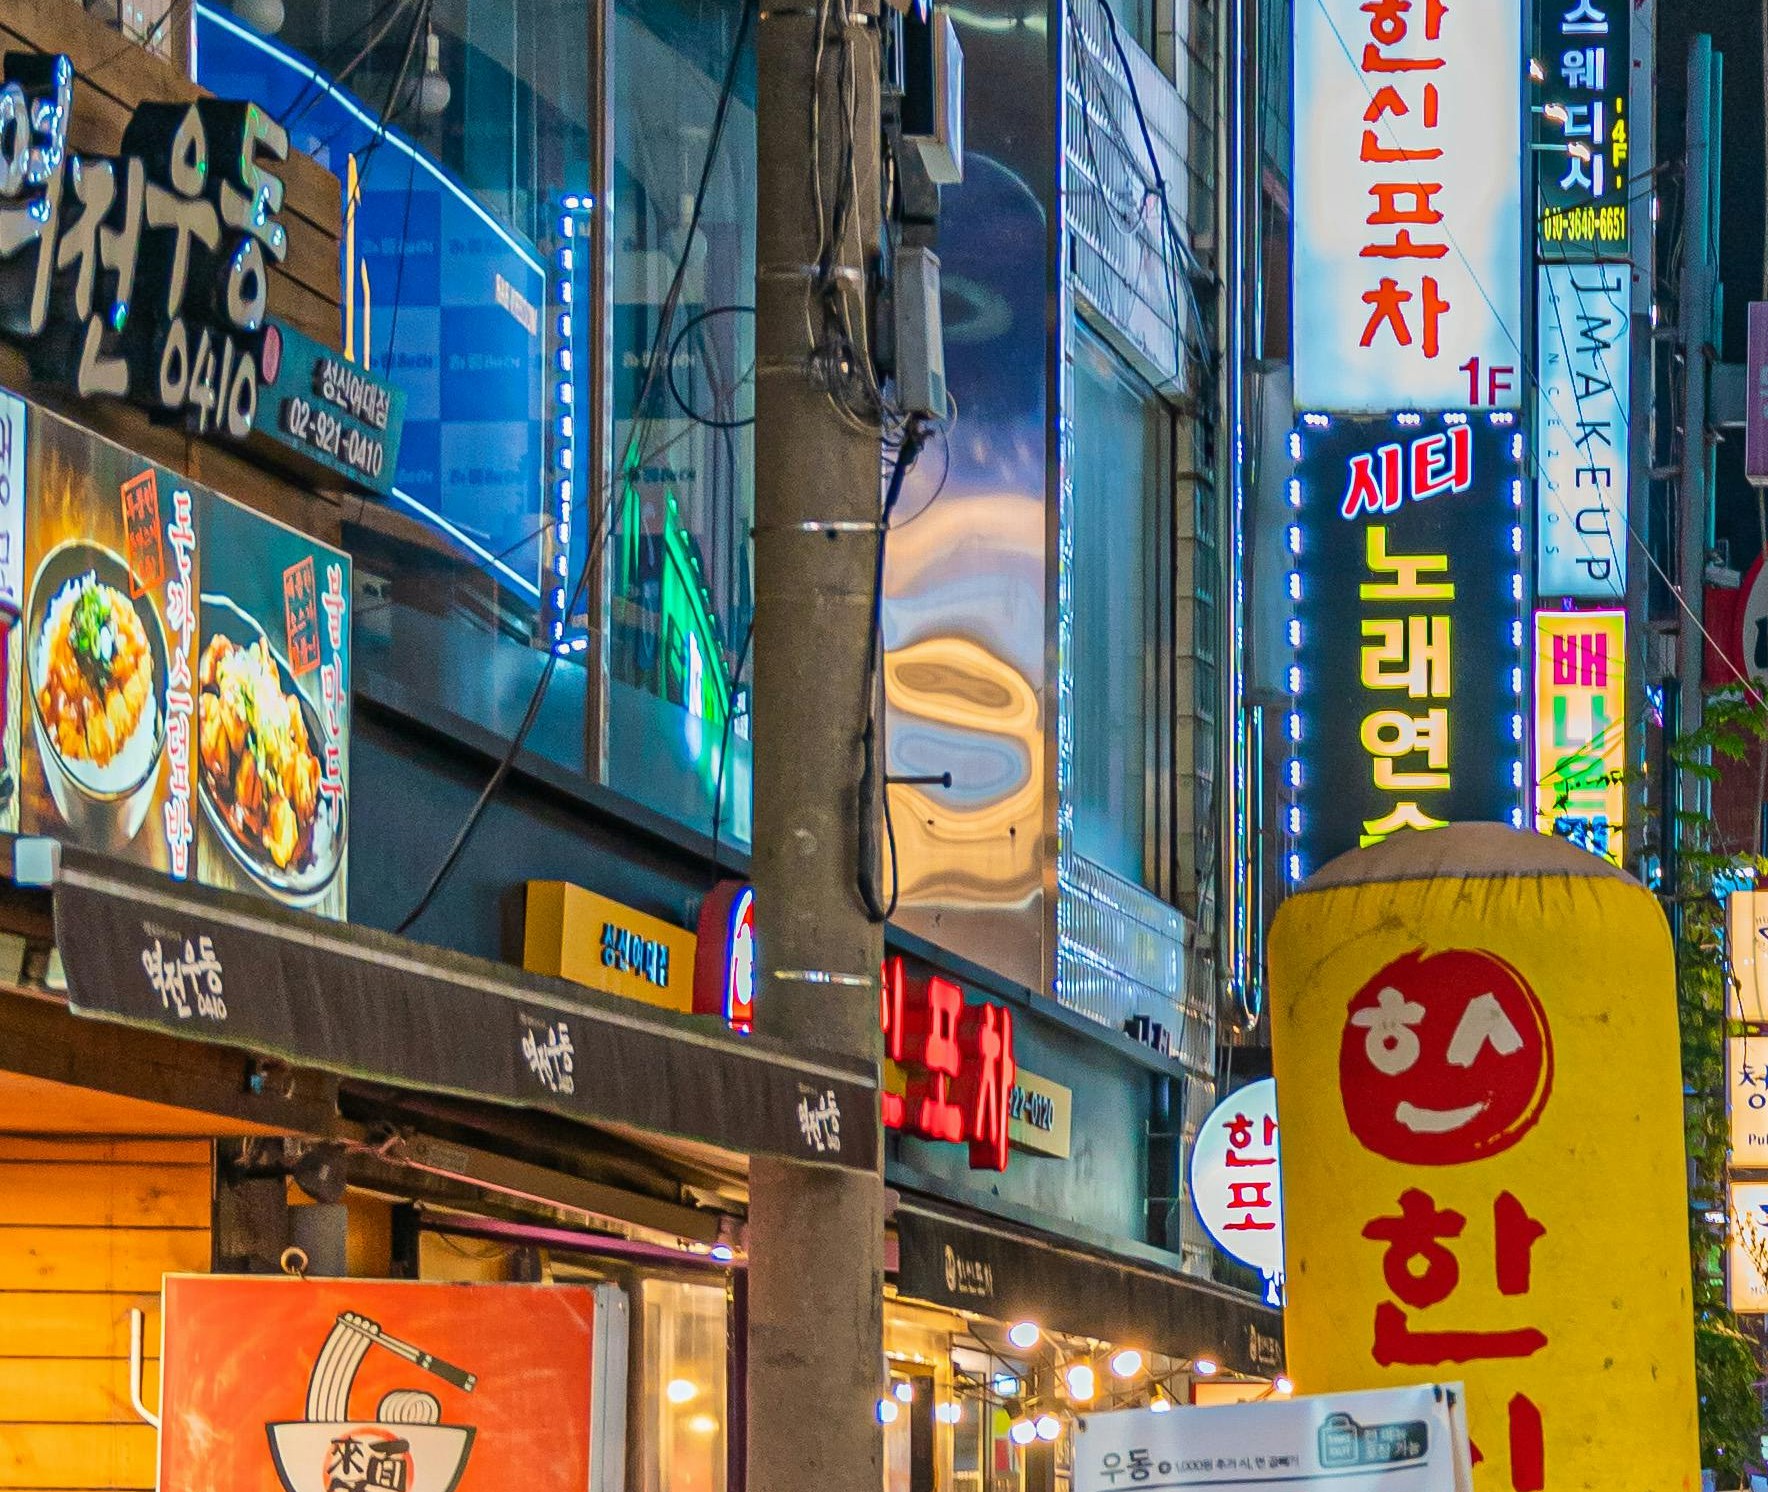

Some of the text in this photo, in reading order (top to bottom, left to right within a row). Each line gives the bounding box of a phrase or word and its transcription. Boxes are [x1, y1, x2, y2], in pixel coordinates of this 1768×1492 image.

[160, 316, 258, 438] 0410
[323, 357, 392, 430] 성신여대점
[1459, 357, 1514, 406] 1F
[1341, 423, 1472, 520] 시티
[1100, 1448, 1152, 1484] 우동
